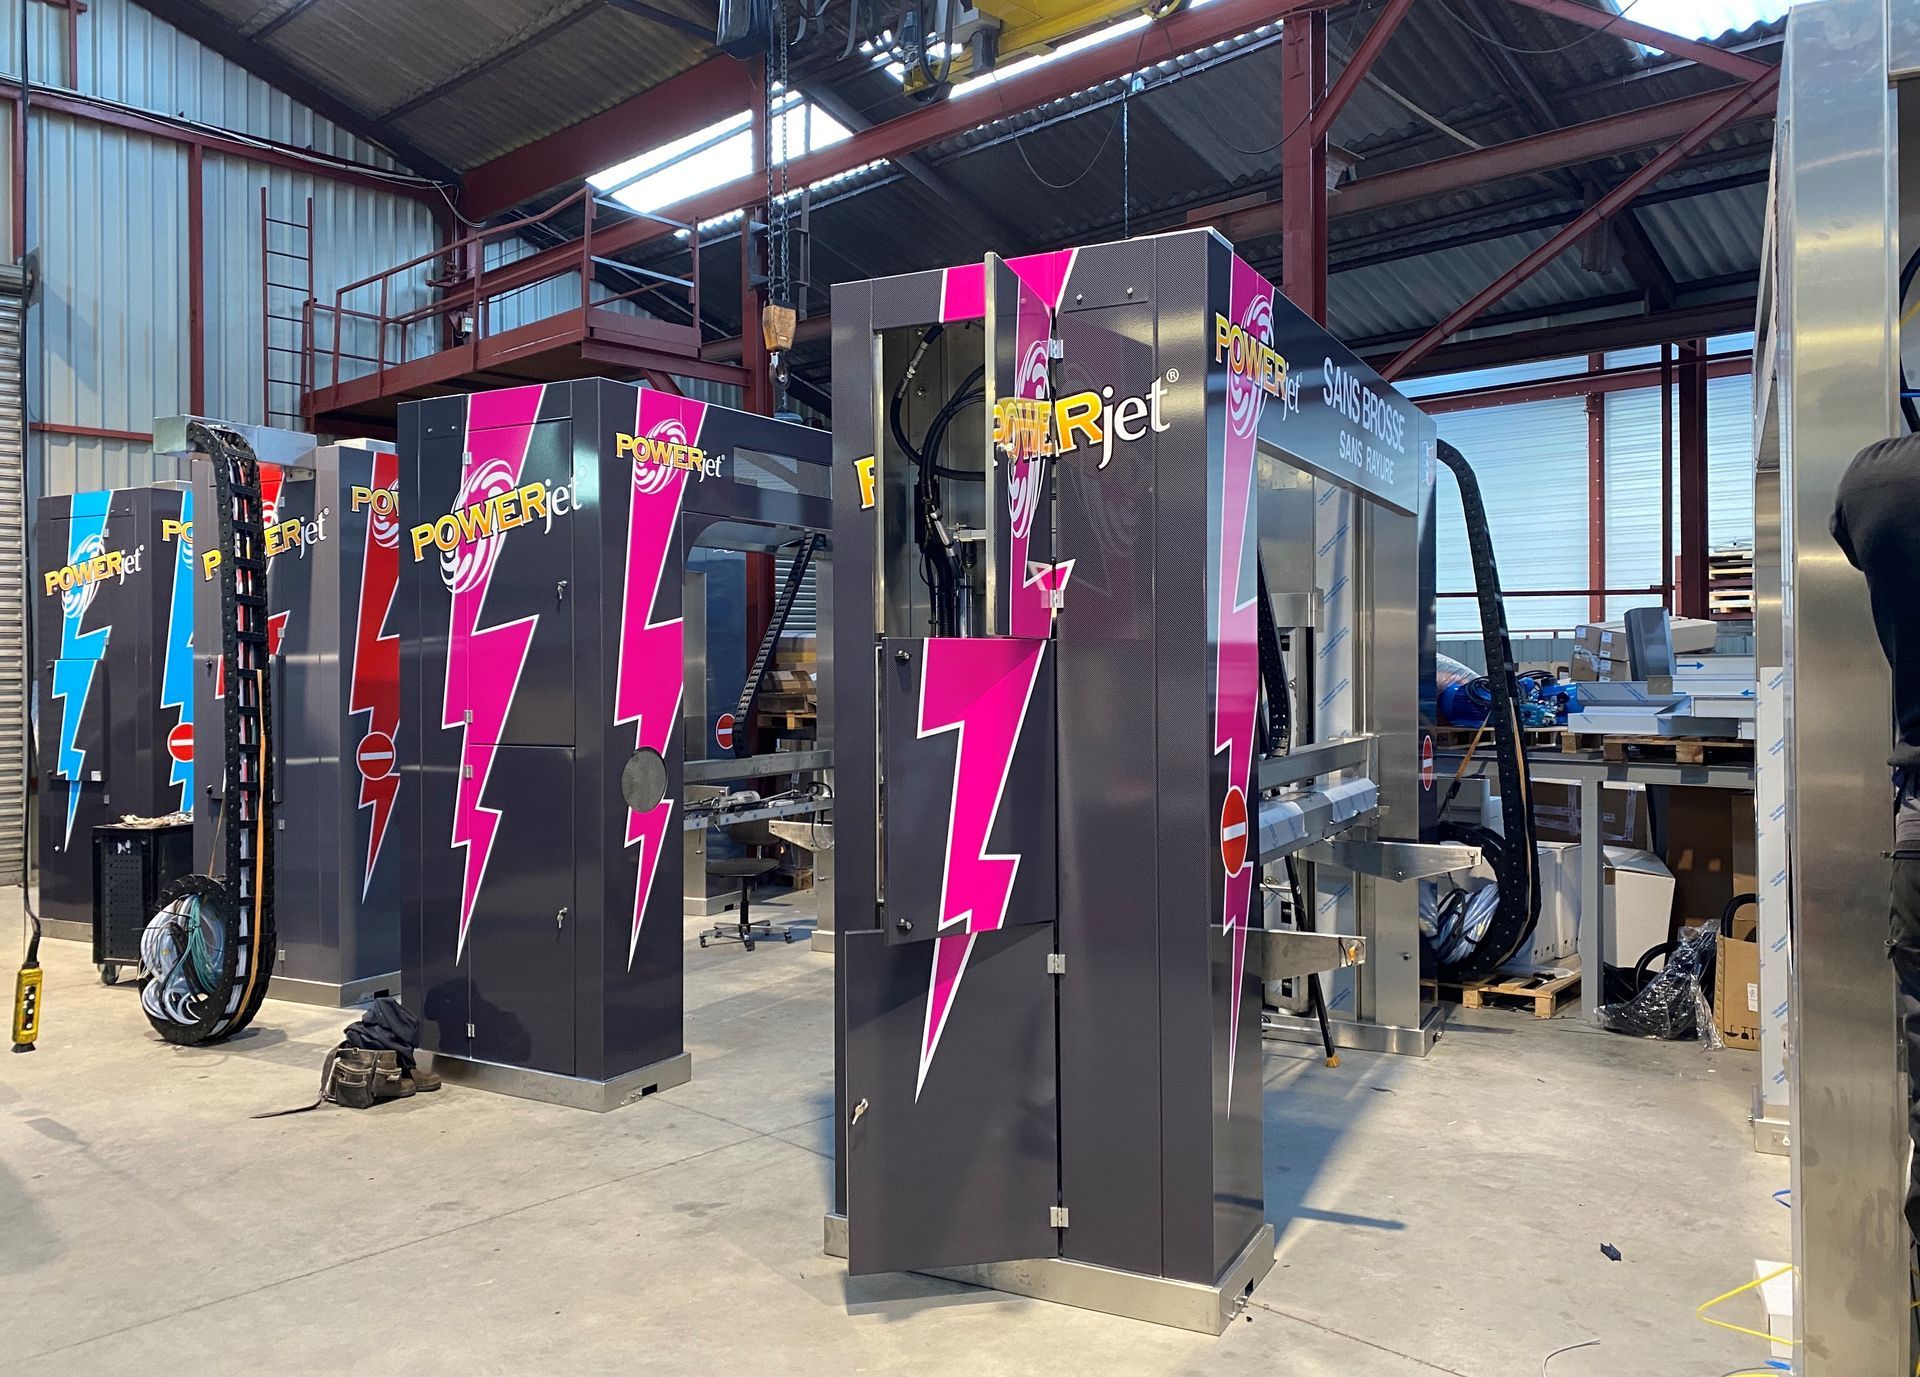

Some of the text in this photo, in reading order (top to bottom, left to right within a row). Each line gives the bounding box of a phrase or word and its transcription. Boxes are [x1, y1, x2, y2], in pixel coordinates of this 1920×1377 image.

[1323, 357, 1405, 453] SANS BROSSE
[1339, 430, 1363, 467] SANS
[1366, 447, 1395, 485] RAYURE
